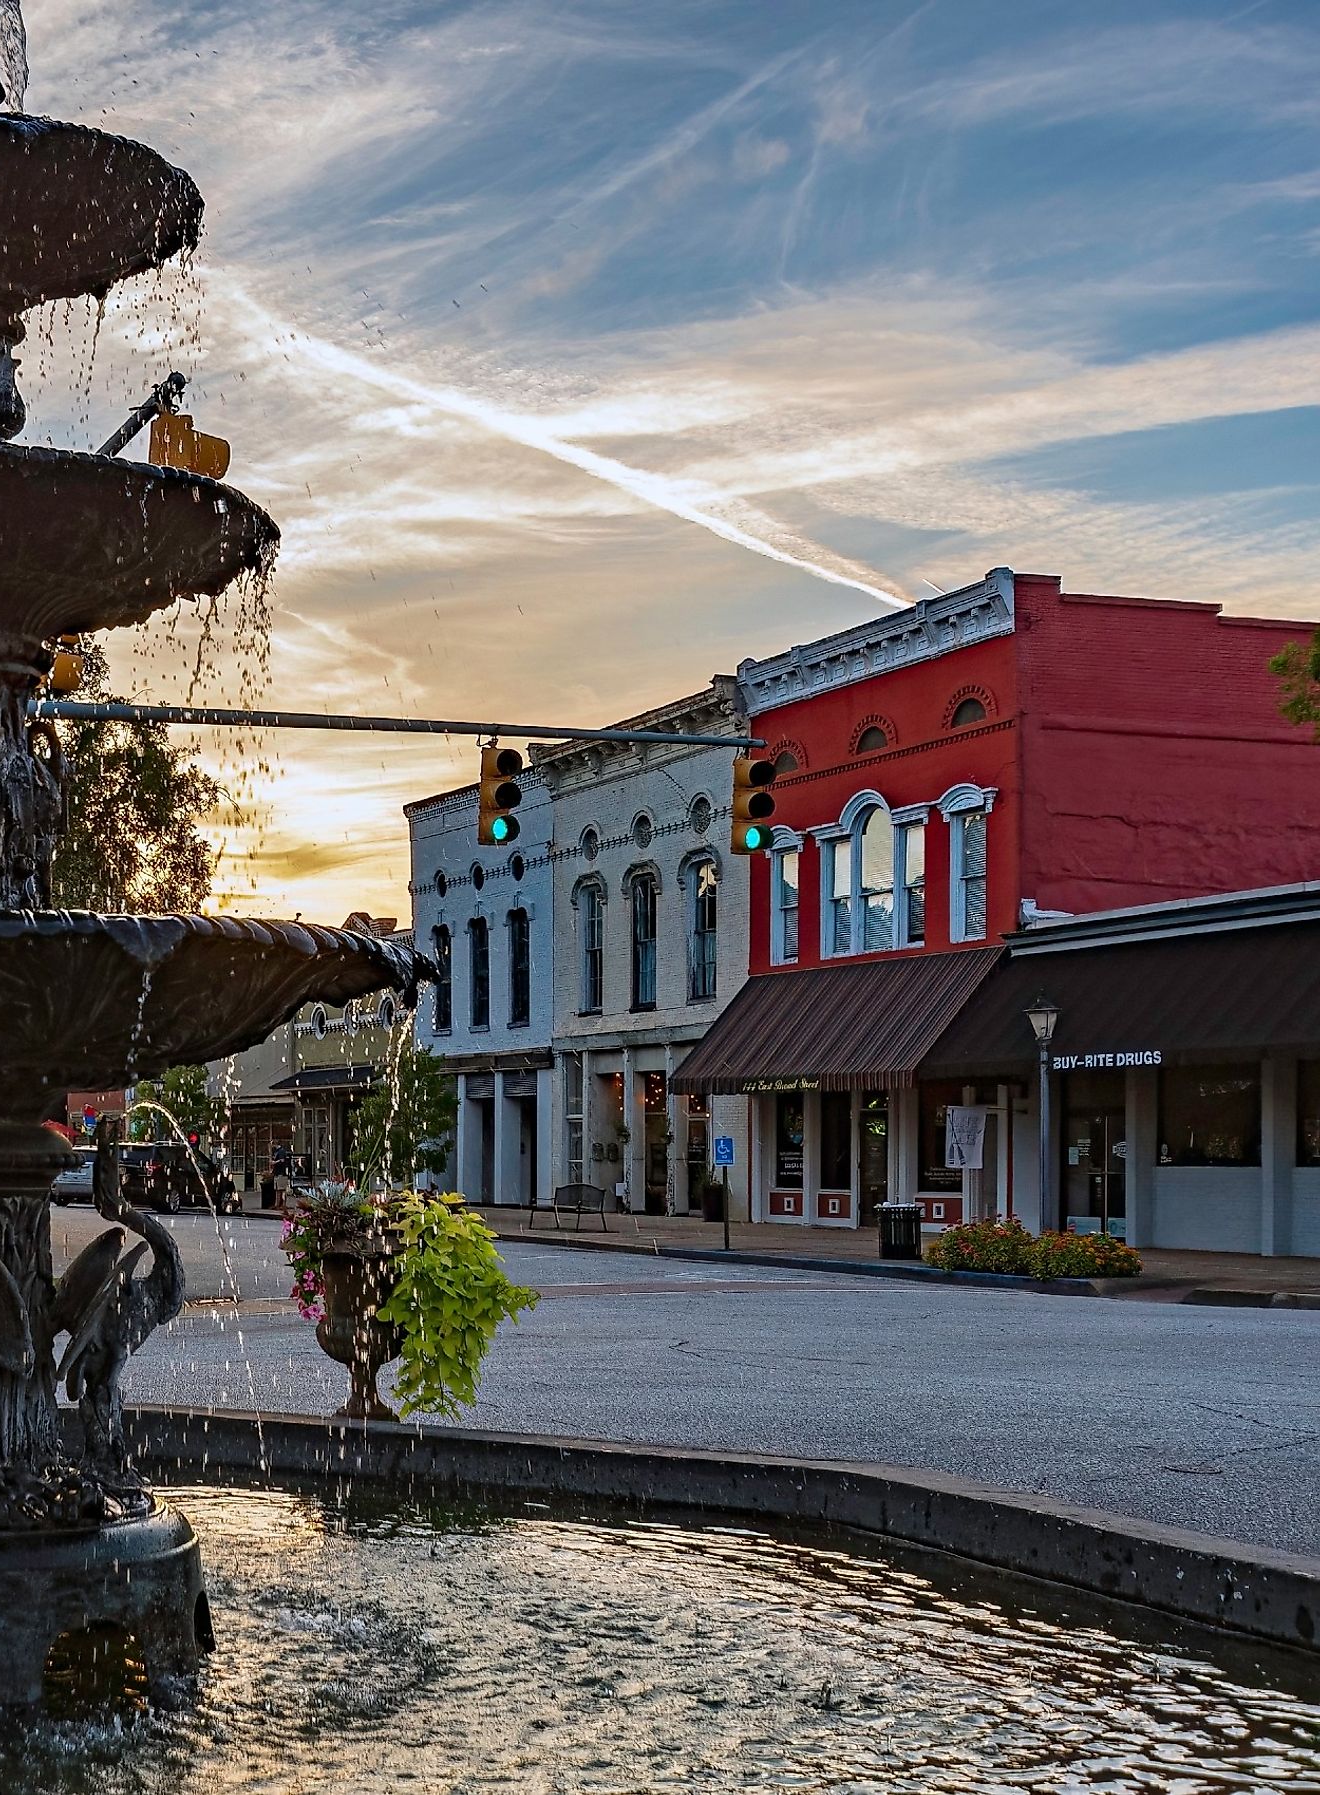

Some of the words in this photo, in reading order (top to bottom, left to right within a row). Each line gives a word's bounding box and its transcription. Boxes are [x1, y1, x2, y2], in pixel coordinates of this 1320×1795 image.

[1053, 1055, 1114, 1069] BUY-RITE
[1116, 1050, 1162, 1066] DRUGS
[758, 1080, 773, 1090] East
[774, 1079, 798, 1091] Broad
[799, 1078, 819, 1090] Street
